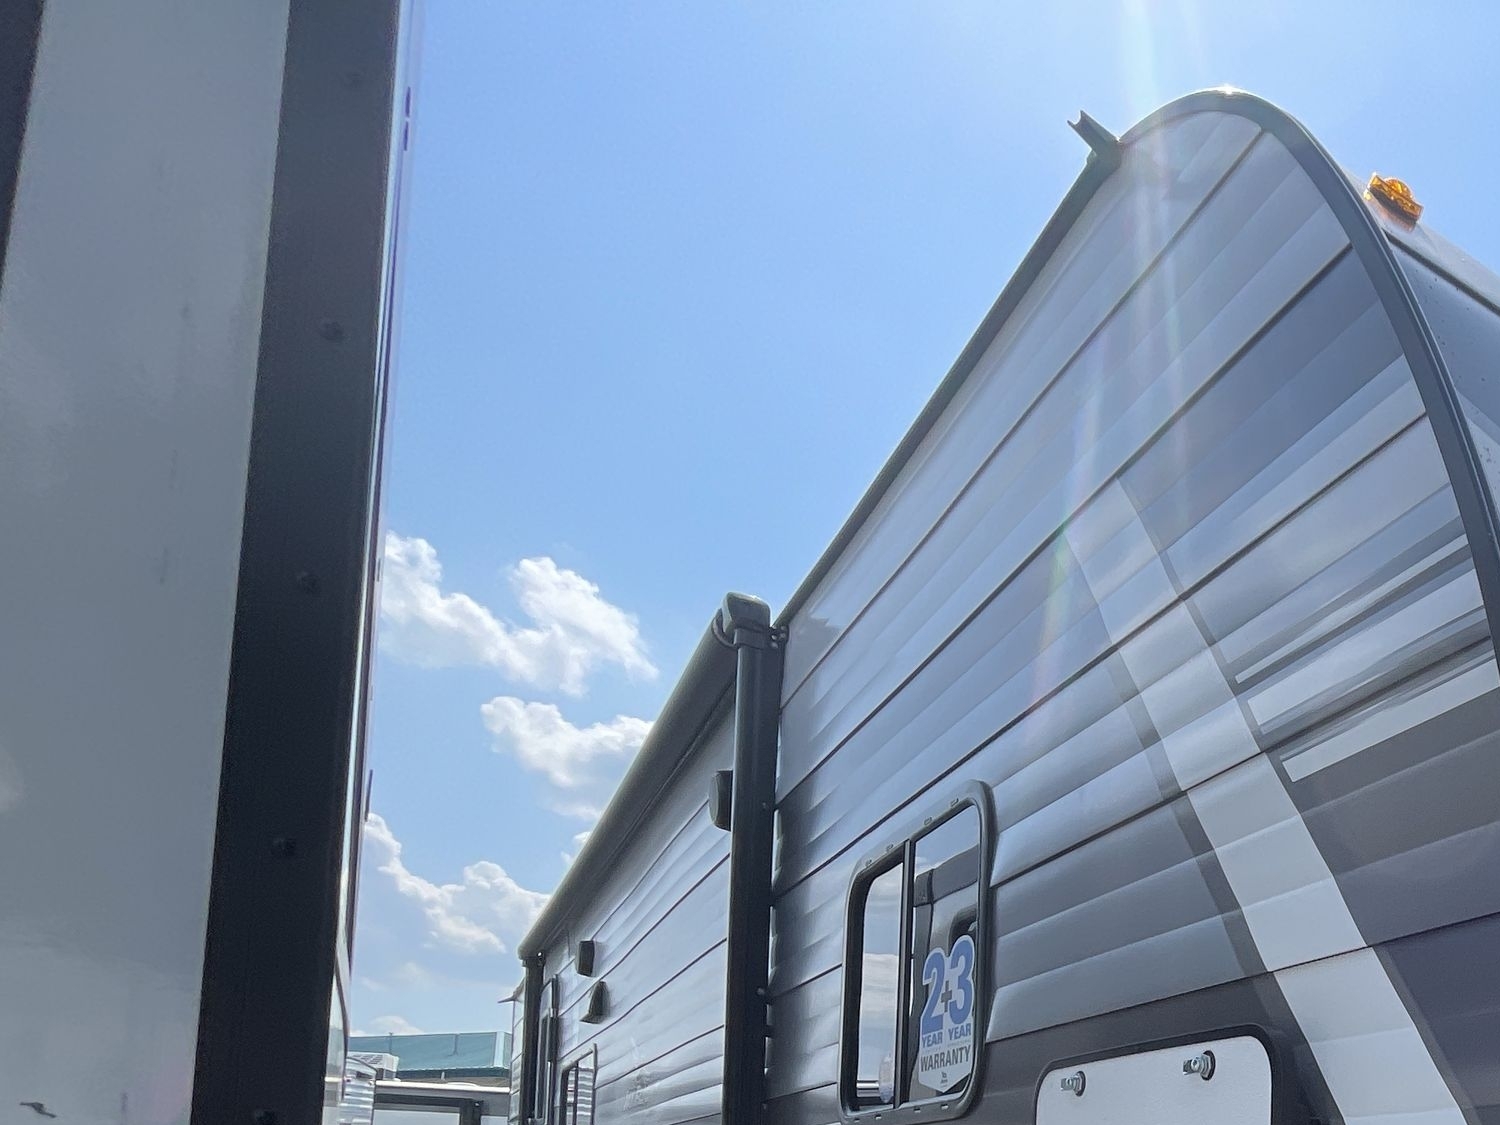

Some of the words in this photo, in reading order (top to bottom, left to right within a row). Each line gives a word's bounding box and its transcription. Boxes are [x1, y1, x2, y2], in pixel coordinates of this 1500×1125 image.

[922, 1031, 943, 1048] YEAR
[948, 1023, 971, 1040] YEAR
[920, 1045, 971, 1072] WARRANTY
